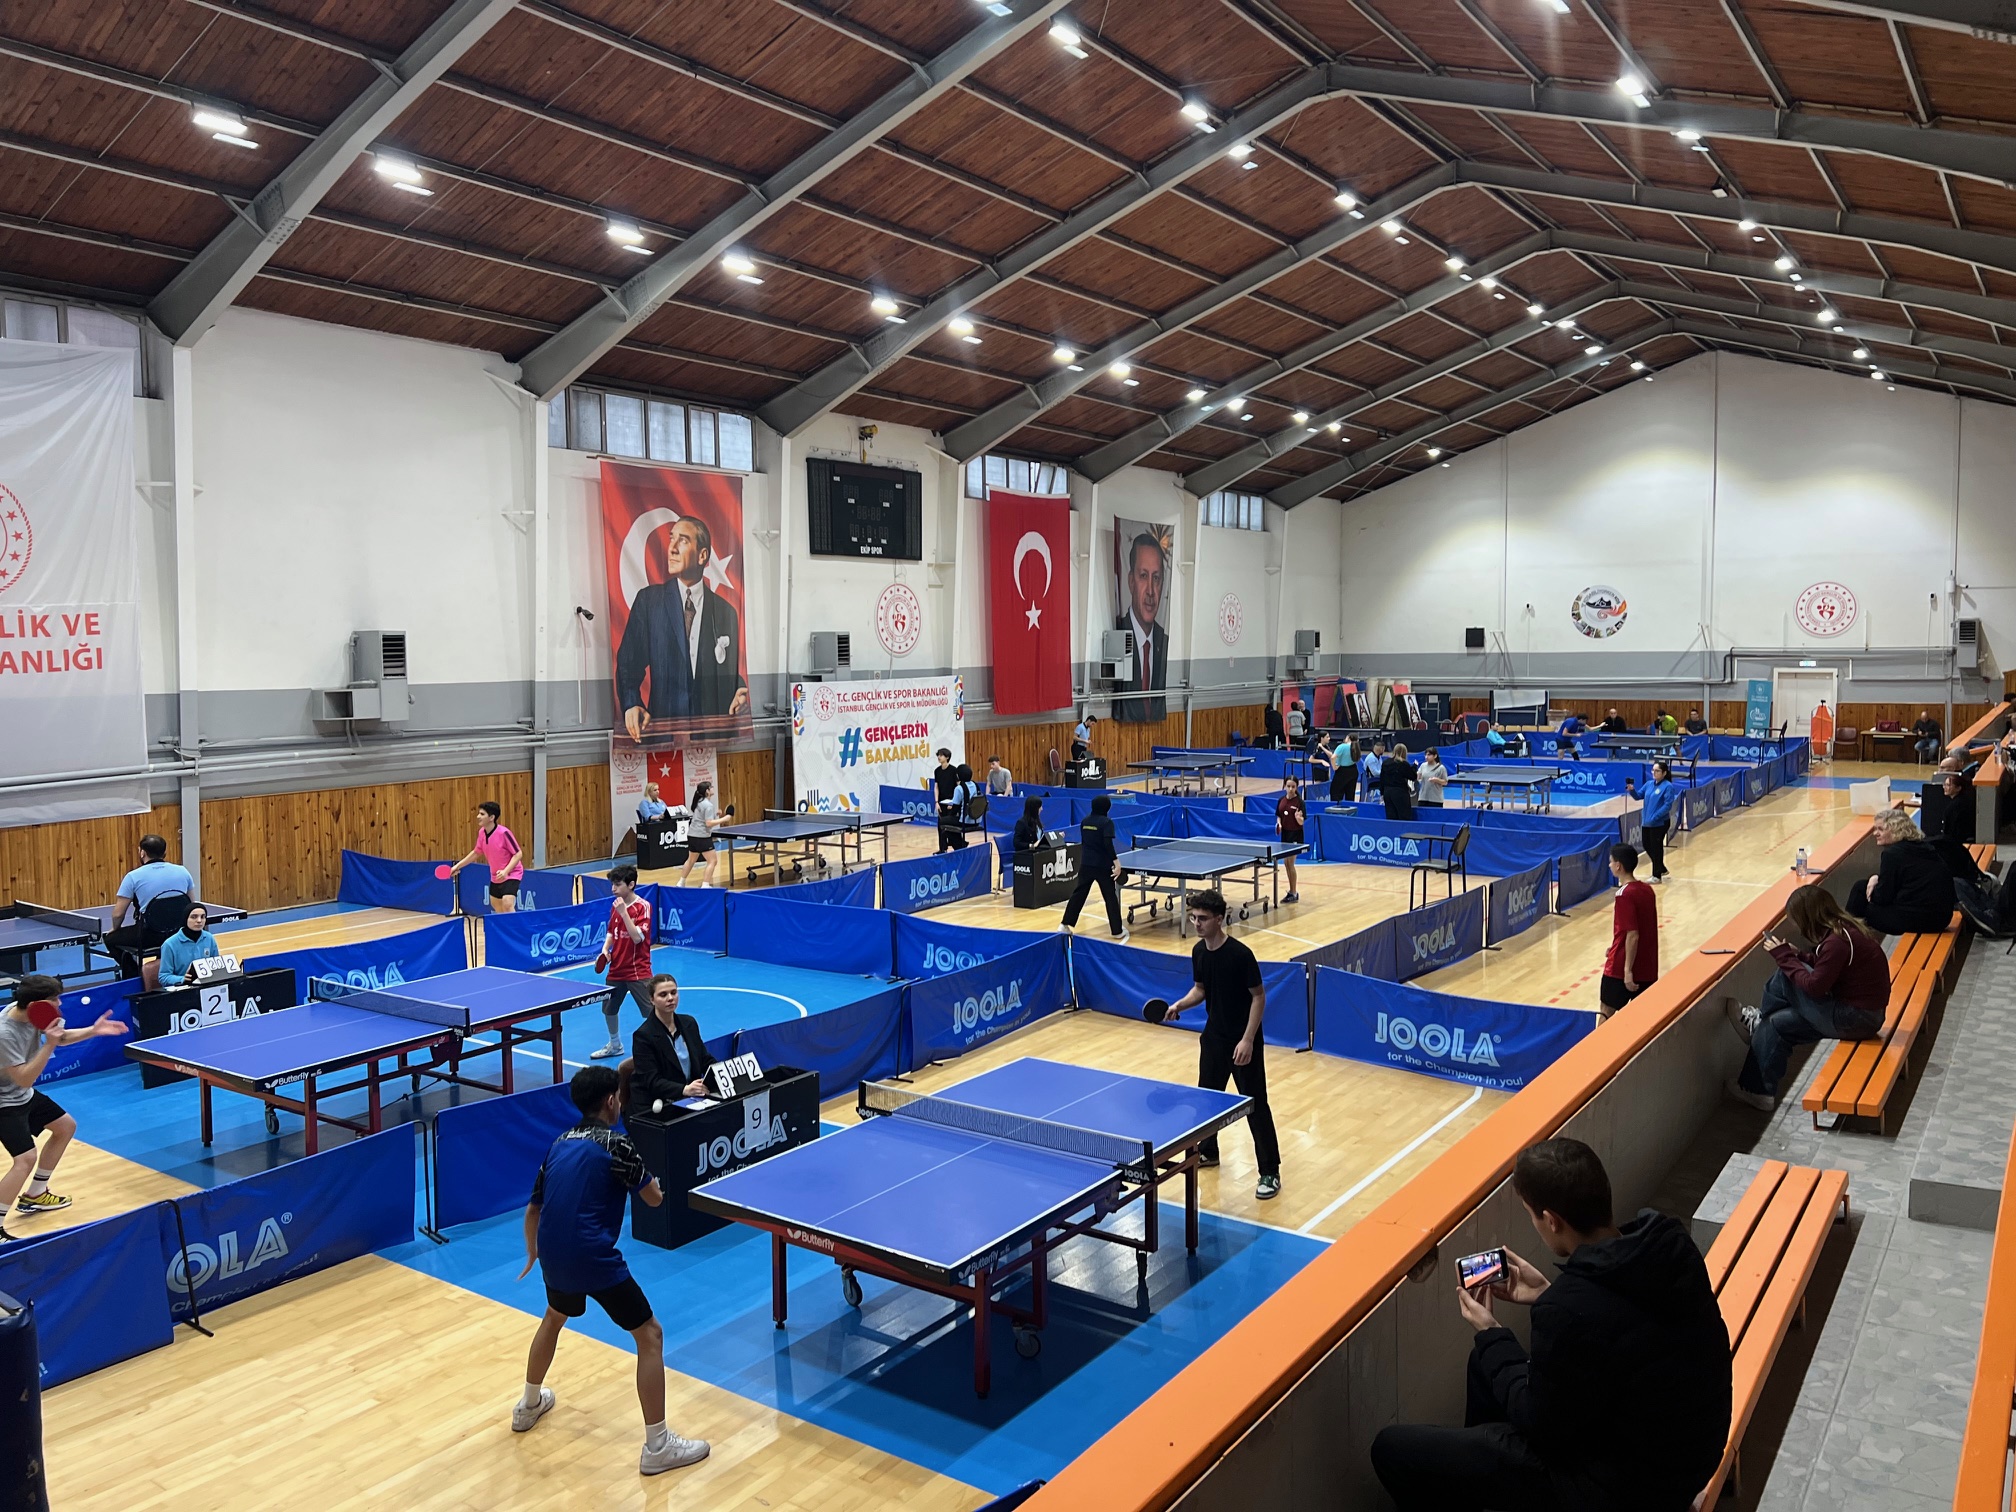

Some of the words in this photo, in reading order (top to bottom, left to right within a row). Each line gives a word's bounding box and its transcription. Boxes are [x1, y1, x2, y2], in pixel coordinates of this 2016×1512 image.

[871, 546, 882, 555] SPOR
[61, 613, 100, 636] VE
[0, 643, 102, 674] ANLIĞI
[837, 693, 850, 703] T.C.
[851, 689, 882, 703] GENÇLİK
[883, 690, 892, 700] VE
[894, 689, 911, 699] SPOR
[913, 686, 948, 697] BAKANLIĞI
[838, 704, 864, 713] İSTANBUL
[866, 701, 888, 712] GENÇLİK
[897, 701, 910, 709] SPOR
[917, 698, 948, 707] MÜDÜRLÜĞÜ
[865, 721, 928, 745] GENÇLERİN
[865, 740, 930, 765] BAKANLIĞI
[1543, 740, 1584, 752] JOA
[1350, 834, 1419, 857] JOOLA
[1014, 865, 1031, 873] JOOLA
[1379, 856, 1410, 867] Champion
[909, 870, 960, 900] JOOLA
[483, 885, 536, 911] JLA
[531, 921, 607, 958] JOOLA
[1412, 922, 1456, 962] JOOLA
[198, 963, 208, 976] 5
[209, 960, 215, 969] 2
[227, 958, 236, 971] 2
[542, 958, 552, 967] for
[554, 954, 566, 963] the
[923, 943, 1000, 972] JOO
[168, 997, 261, 1035] JOLA
[208, 995, 222, 1016] 2
[953, 980, 1022, 1035] JOOLA
[975, 1028, 986, 1038] the
[1375, 1011, 1501, 1067] JOOLA
[54, 1059, 81, 1079] you!
[278, 1071, 310, 1086] Butterfly
[718, 1069, 729, 1088] 5
[729, 1062, 736, 1077] 1
[736, 1060, 744, 1075] 1
[748, 1059, 760, 1079] 2
[1387, 1051, 1402, 1061] for
[1405, 1054, 1422, 1066] the
[1425, 1060, 1483, 1083] Champion
[1485, 1076, 1496, 1085] in
[1499, 1076, 1523, 1088] you!
[752, 1108, 761, 1129] 9
[697, 1114, 788, 1176] JOOA
[721, 1165, 735, 1178] the
[1124, 1168, 1150, 1181] JOOLA
[801, 1231, 834, 1251] Butterfly
[971, 1249, 998, 1274] Butterfly
